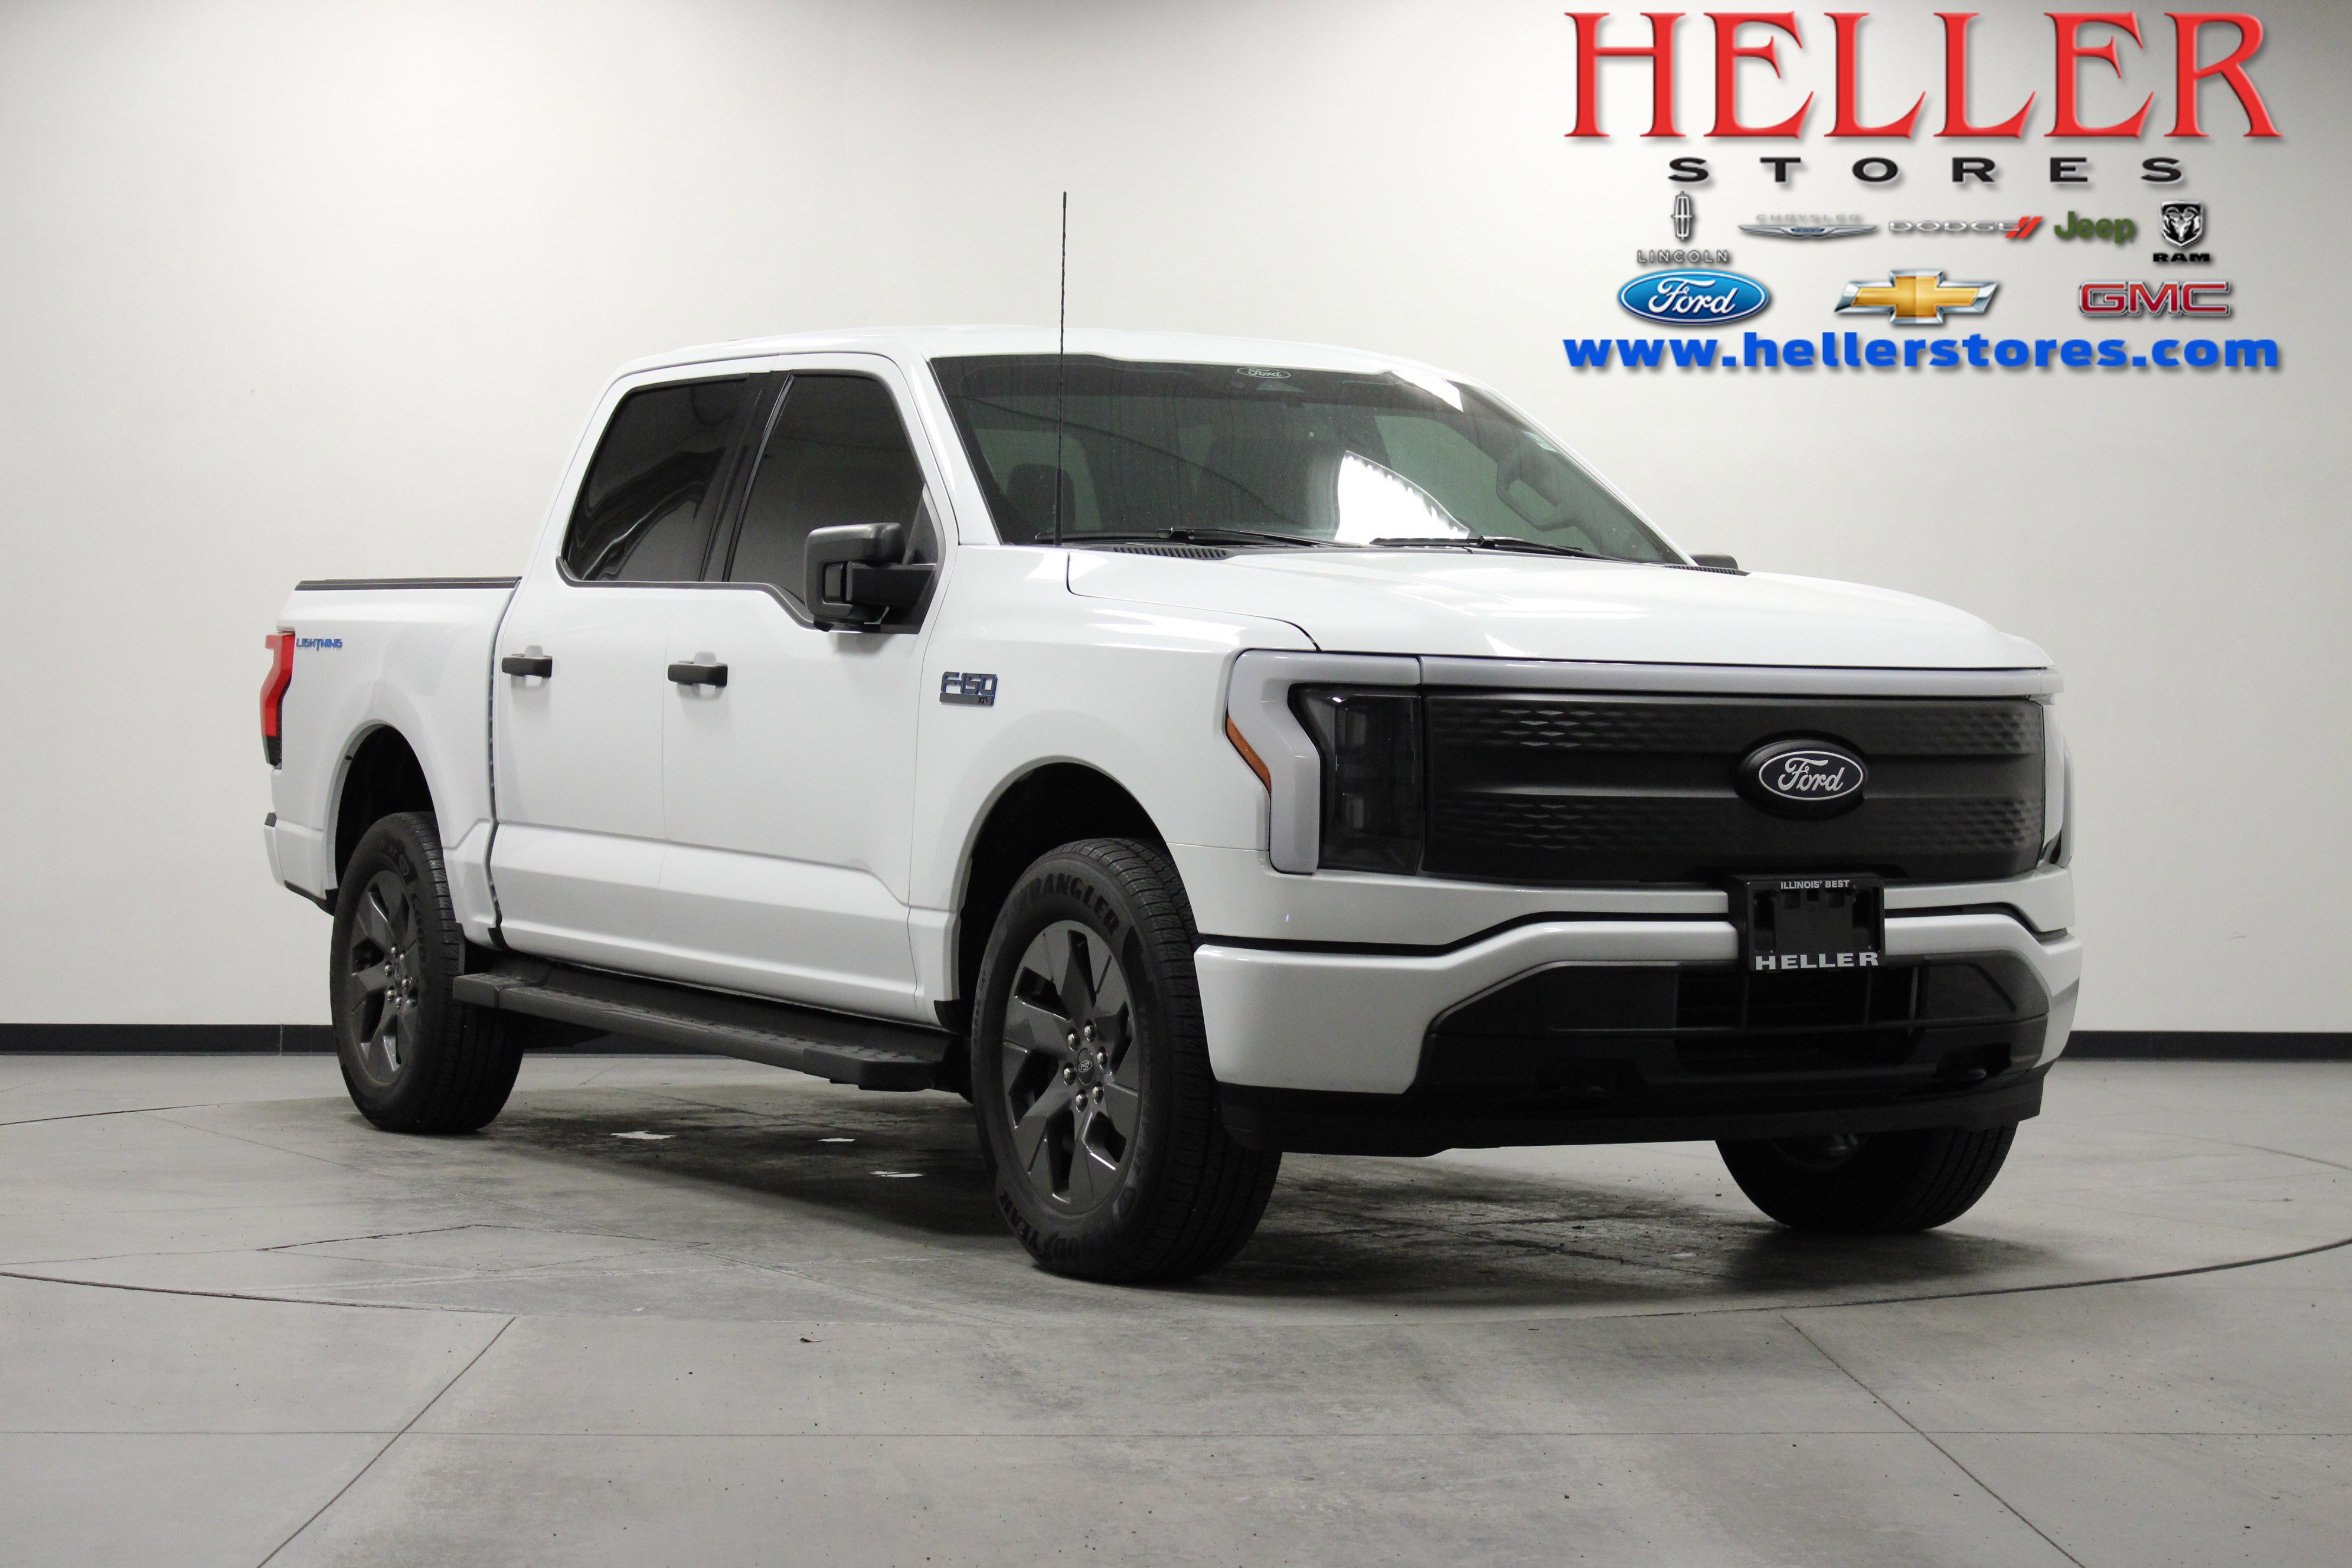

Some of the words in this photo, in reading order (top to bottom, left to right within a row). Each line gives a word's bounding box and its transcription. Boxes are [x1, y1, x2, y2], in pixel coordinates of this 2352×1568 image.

[1247, 368, 1282, 377] Ford
[296, 638, 343, 652] LIGHTNING
[1778, 757, 1845, 792] Ford
[1780, 880, 1822, 890] ILLINOIS'
[1825, 880, 1850, 888] BEST
[1755, 952, 1879, 971] HELLER
